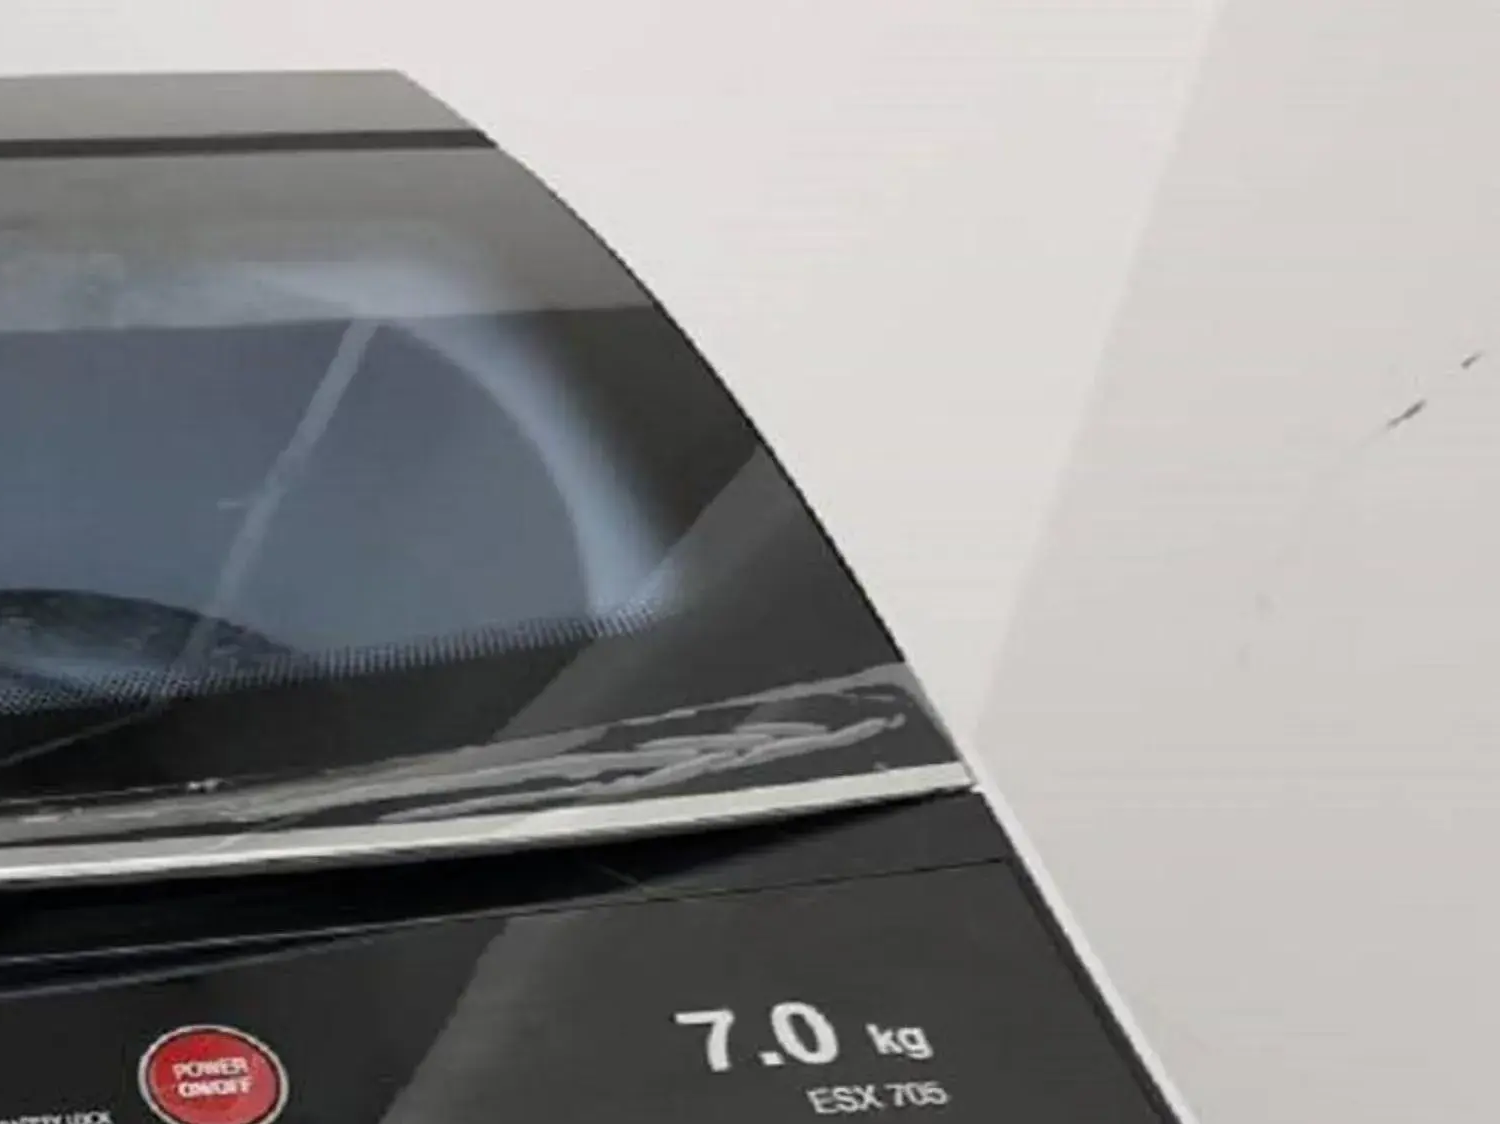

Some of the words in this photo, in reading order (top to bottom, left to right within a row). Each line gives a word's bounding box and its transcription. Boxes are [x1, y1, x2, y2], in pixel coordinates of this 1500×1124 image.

[674, 1000, 839, 1072] 7.0
[866, 1023, 934, 1059] kg
[172, 1056, 249, 1081] POWER
[806, 1084, 884, 1114] ESX
[885, 1081, 950, 1107] 705
